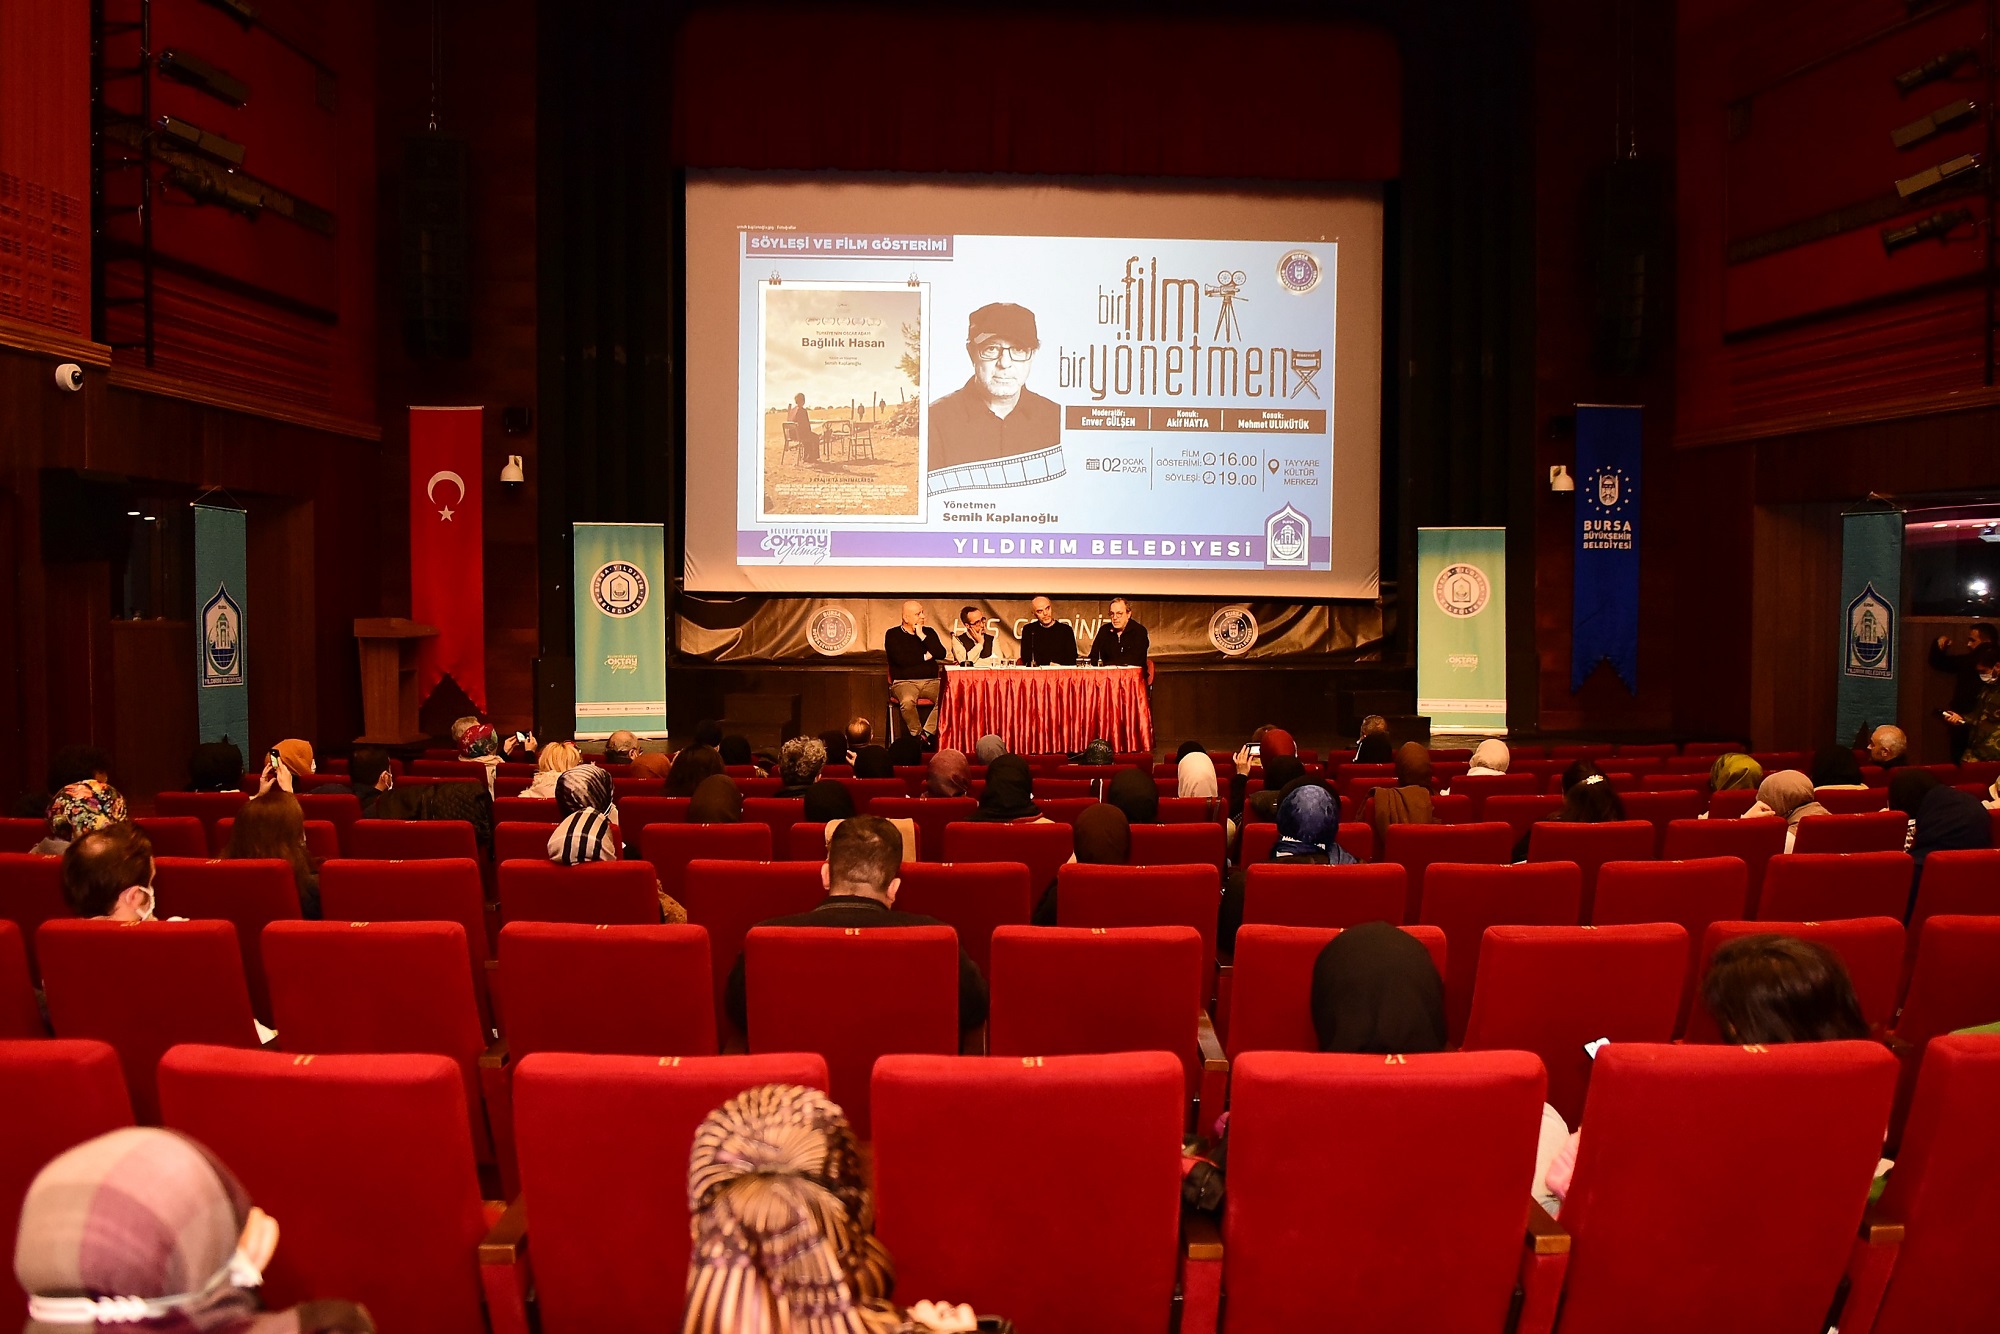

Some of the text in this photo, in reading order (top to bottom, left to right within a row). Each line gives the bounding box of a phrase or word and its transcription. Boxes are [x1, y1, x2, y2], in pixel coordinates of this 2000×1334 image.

[751, 236, 947, 251] SÖYLEŞİ VE FİLM GÖSTERİMİ
[1098, 256, 1199, 342] bir film
[801, 337, 885, 350] Bağlılık Hasan
[1059, 332, 1287, 401] bir yönetmen
[1176, 410, 1199, 418] Konuk:
[1081, 416, 1136, 429] Enver GÜLŞEN
[1166, 417, 1209, 428] Akif HAYTA
[1238, 419, 1310, 430] Mehmet ULUKÜTÜK
[1181, 449, 1200, 457] FİLM
[1156, 459, 1202, 467] GÖSTERİMİ:
[1218, 452, 1257, 466] 16.00
[1284, 459, 1320, 467] TAYYARE
[1102, 457, 1121, 473] 02
[1283, 468, 1315, 476] KÜLTÜR
[1165, 473, 1201, 483] SÖYLEŞİ:
[1218, 471, 1257, 485] 19.00
[1283, 477, 1319, 486] MERKEZİ
[943, 501, 996, 509] Yönetmen
[943, 512, 1059, 524] Semih Kaplanoğlu
[1583, 520, 1632, 531] BURSA
[770, 534, 828, 547] OKTAY
[1583, 531, 1632, 540] BÜYÜKŞEHİR
[953, 538, 1252, 557] YILDIRIM BELEDİYESİ
[1583, 540, 1632, 549] BELEDİYESİ
